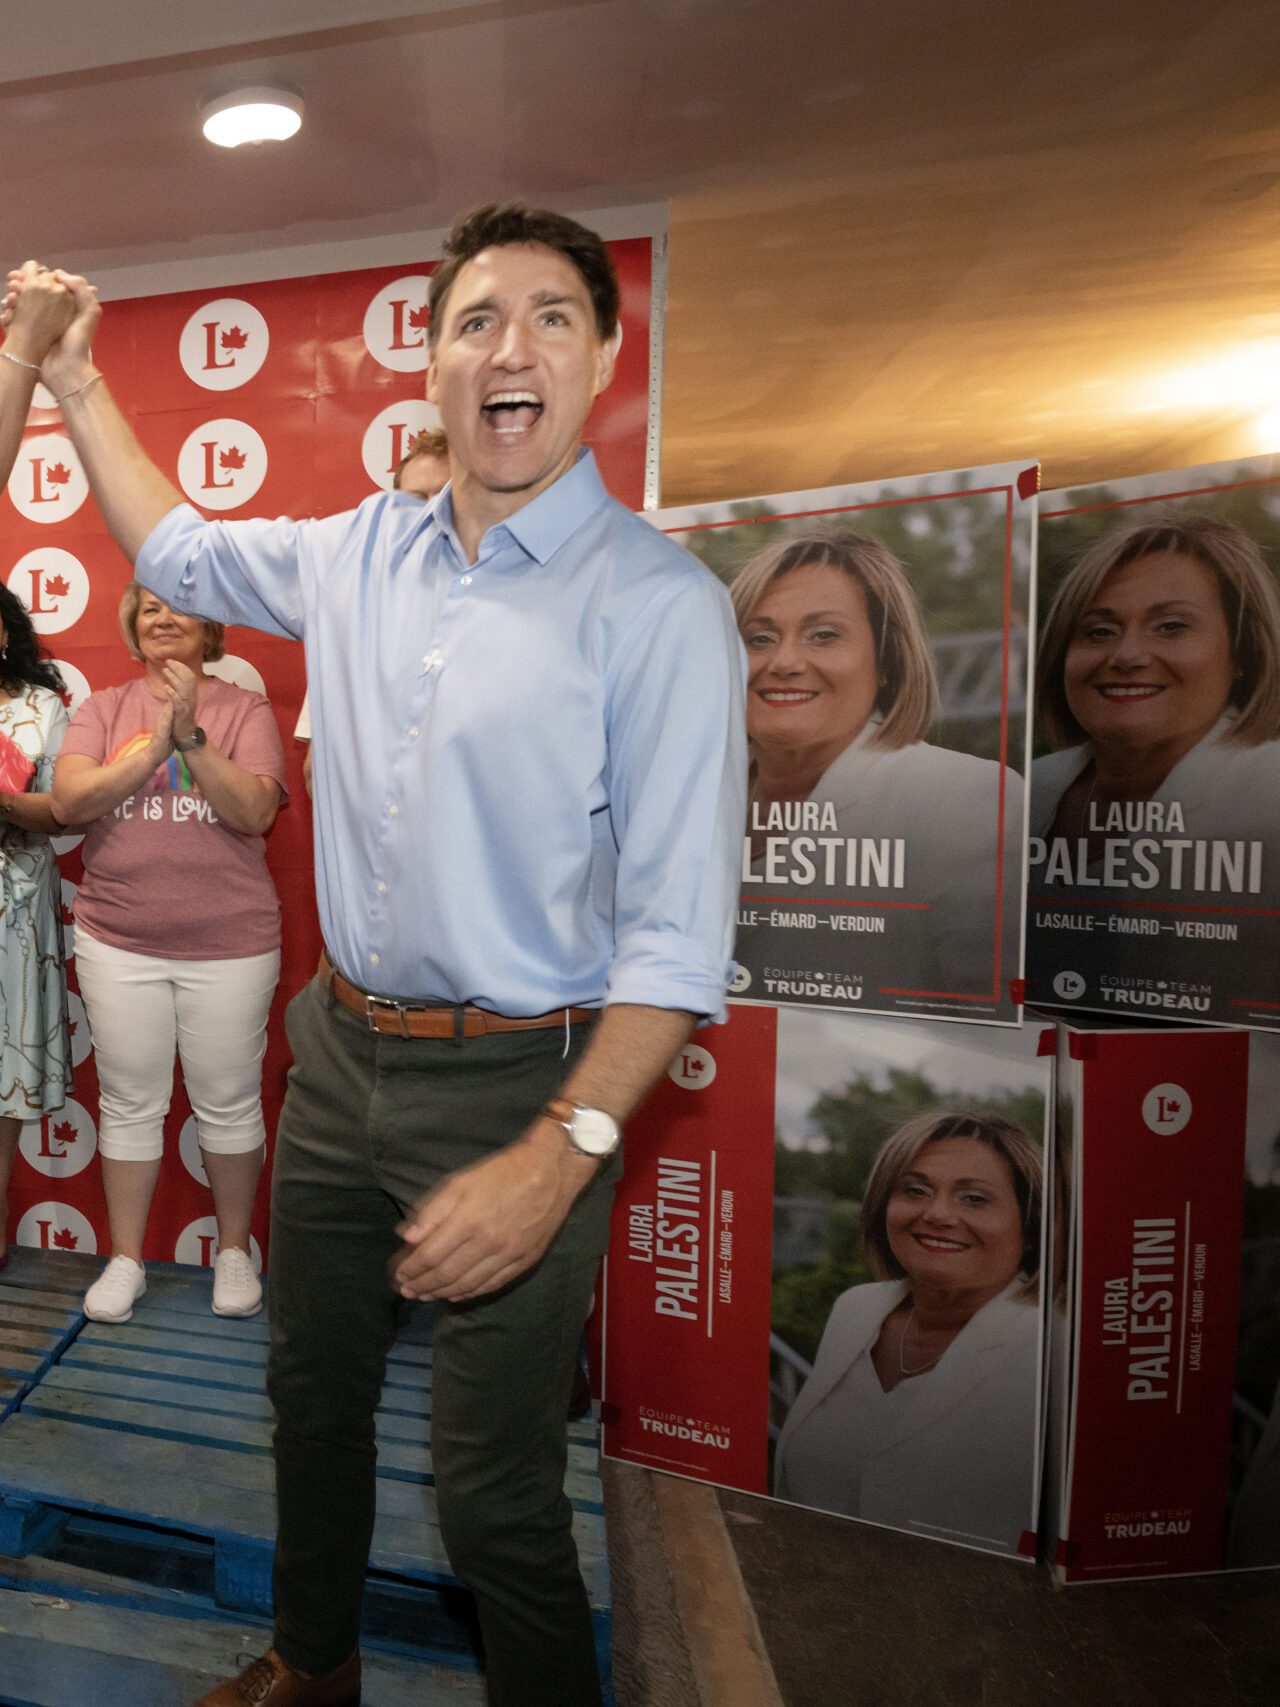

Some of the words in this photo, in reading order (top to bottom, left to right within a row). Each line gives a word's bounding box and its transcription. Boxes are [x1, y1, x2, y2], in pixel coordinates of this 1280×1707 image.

[202, 321, 235, 370] L
[388, 300, 424, 350] L
[29, 457, 60, 504] L
[200, 441, 234, 489] L
[27, 568, 59, 614] L
[751, 801, 839, 832] LAURA
[1089, 800, 1185, 833] LAURA
[741, 836, 906, 889] LESTINI
[1027, 836, 1263, 894] PALESTINI
[736, 909, 885, 933] LLE—ÉMARD—VERDUN
[763, 966, 812, 981] ÉQUIPE
[826, 972, 863, 984] TEAM
[763, 979, 863, 1000] TRUDEAU
[1099, 974, 1153, 989] ÉQUIPE
[1170, 981, 1212, 995] TEAM
[1099, 987, 1211, 1012] TRUDEAU
[37, 1113, 68, 1159] L
[628, 1204, 654, 1263] LAURA
[655, 1157, 701, 1321] PALESTINI
[1102, 1276, 1129, 1346] LAURA
[1127, 1217, 1176, 1401] PALESTINI
[639, 1417, 731, 1450] TRUDEAU
[696, 1420, 731, 1435] TEAM
[1104, 1519, 1191, 1539] TRUDEAU
